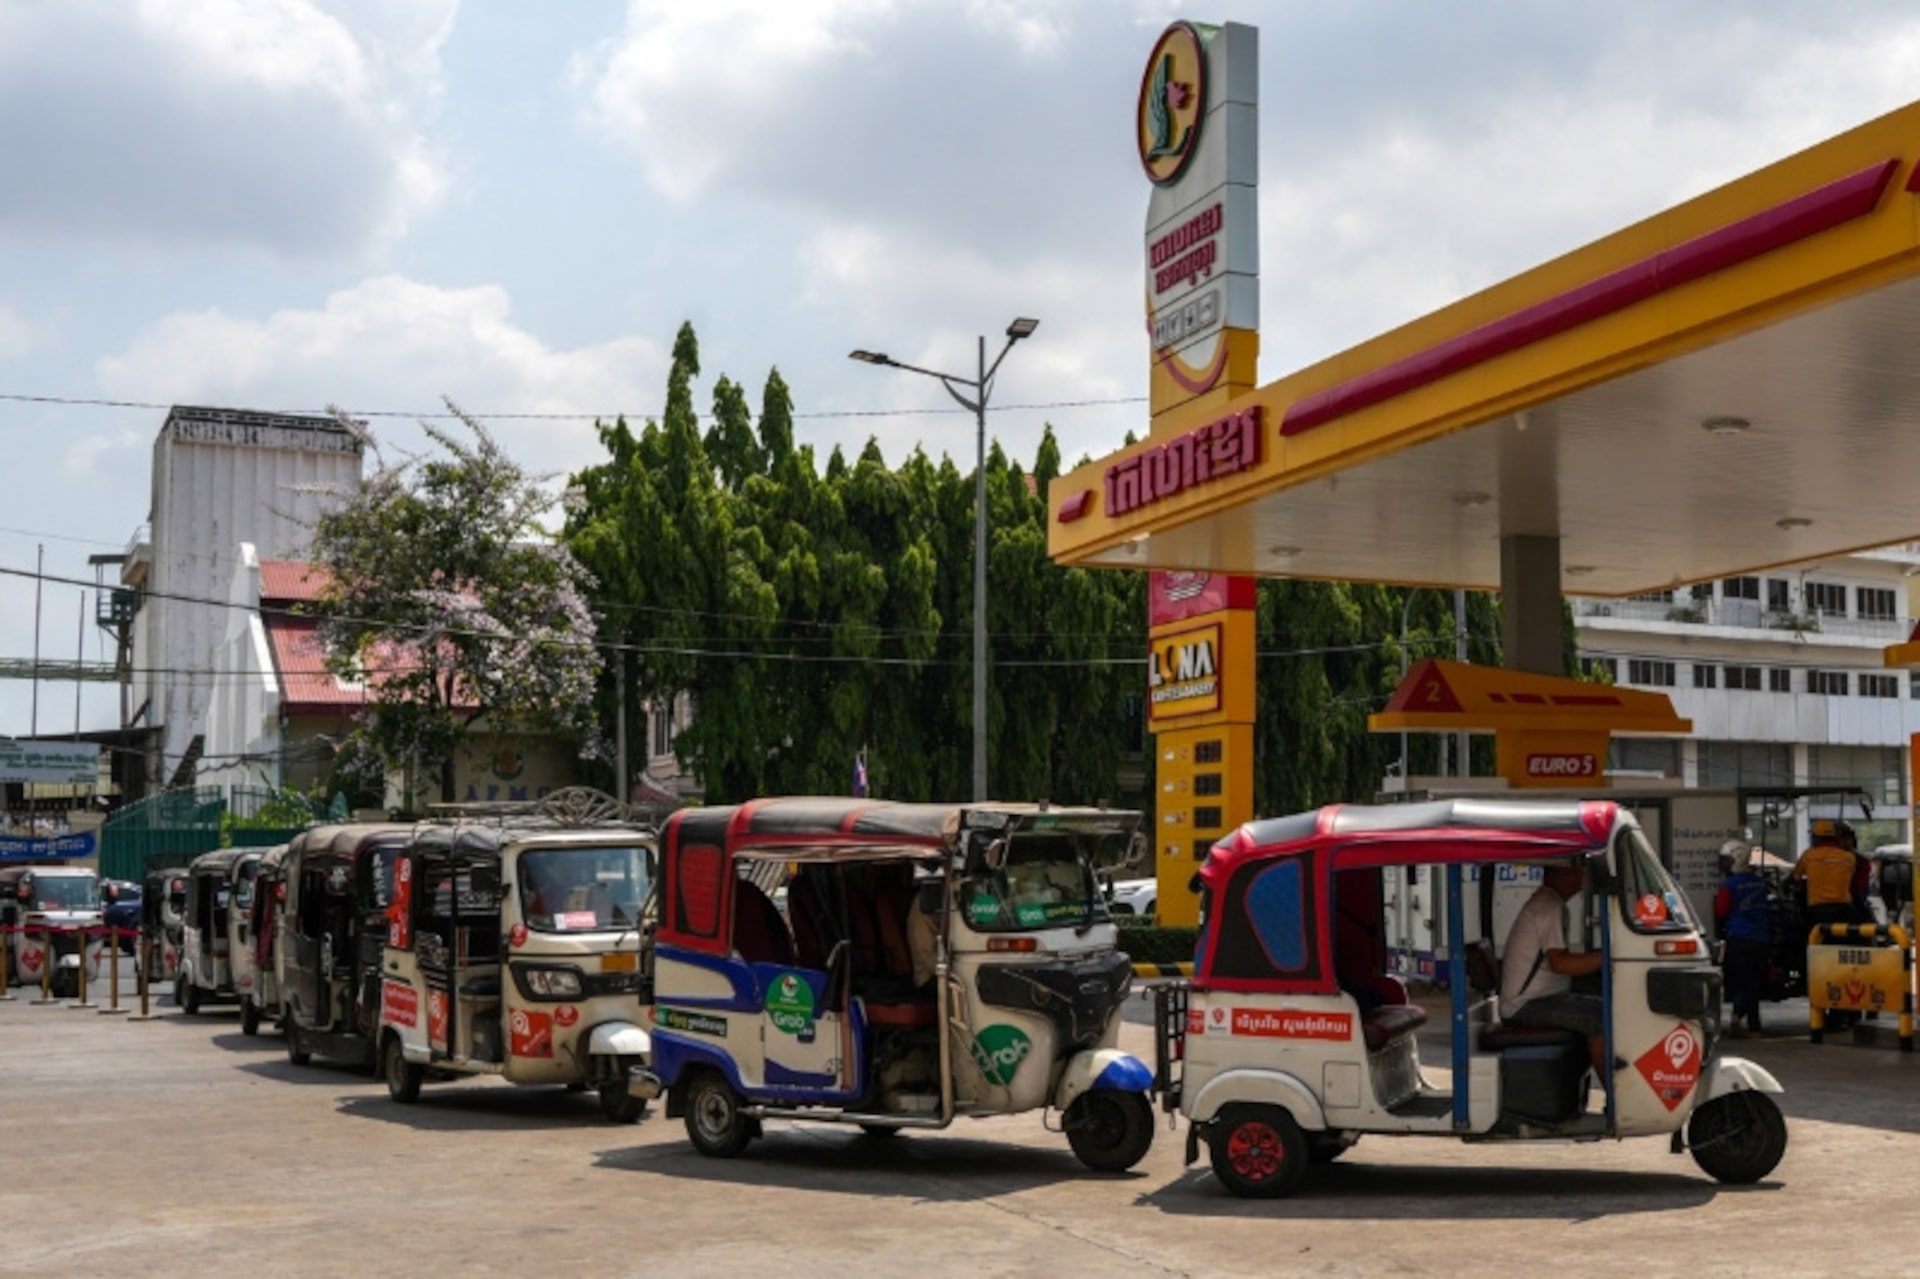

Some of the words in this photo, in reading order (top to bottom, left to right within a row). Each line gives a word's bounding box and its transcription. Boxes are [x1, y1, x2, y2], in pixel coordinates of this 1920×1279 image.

[1426, 681, 1440, 702] 2
[1528, 757, 1580, 774] EURO
[1582, 755, 1593, 774] 5
[774, 1011, 805, 1028] Grab
[975, 1038, 1030, 1071] Grab
